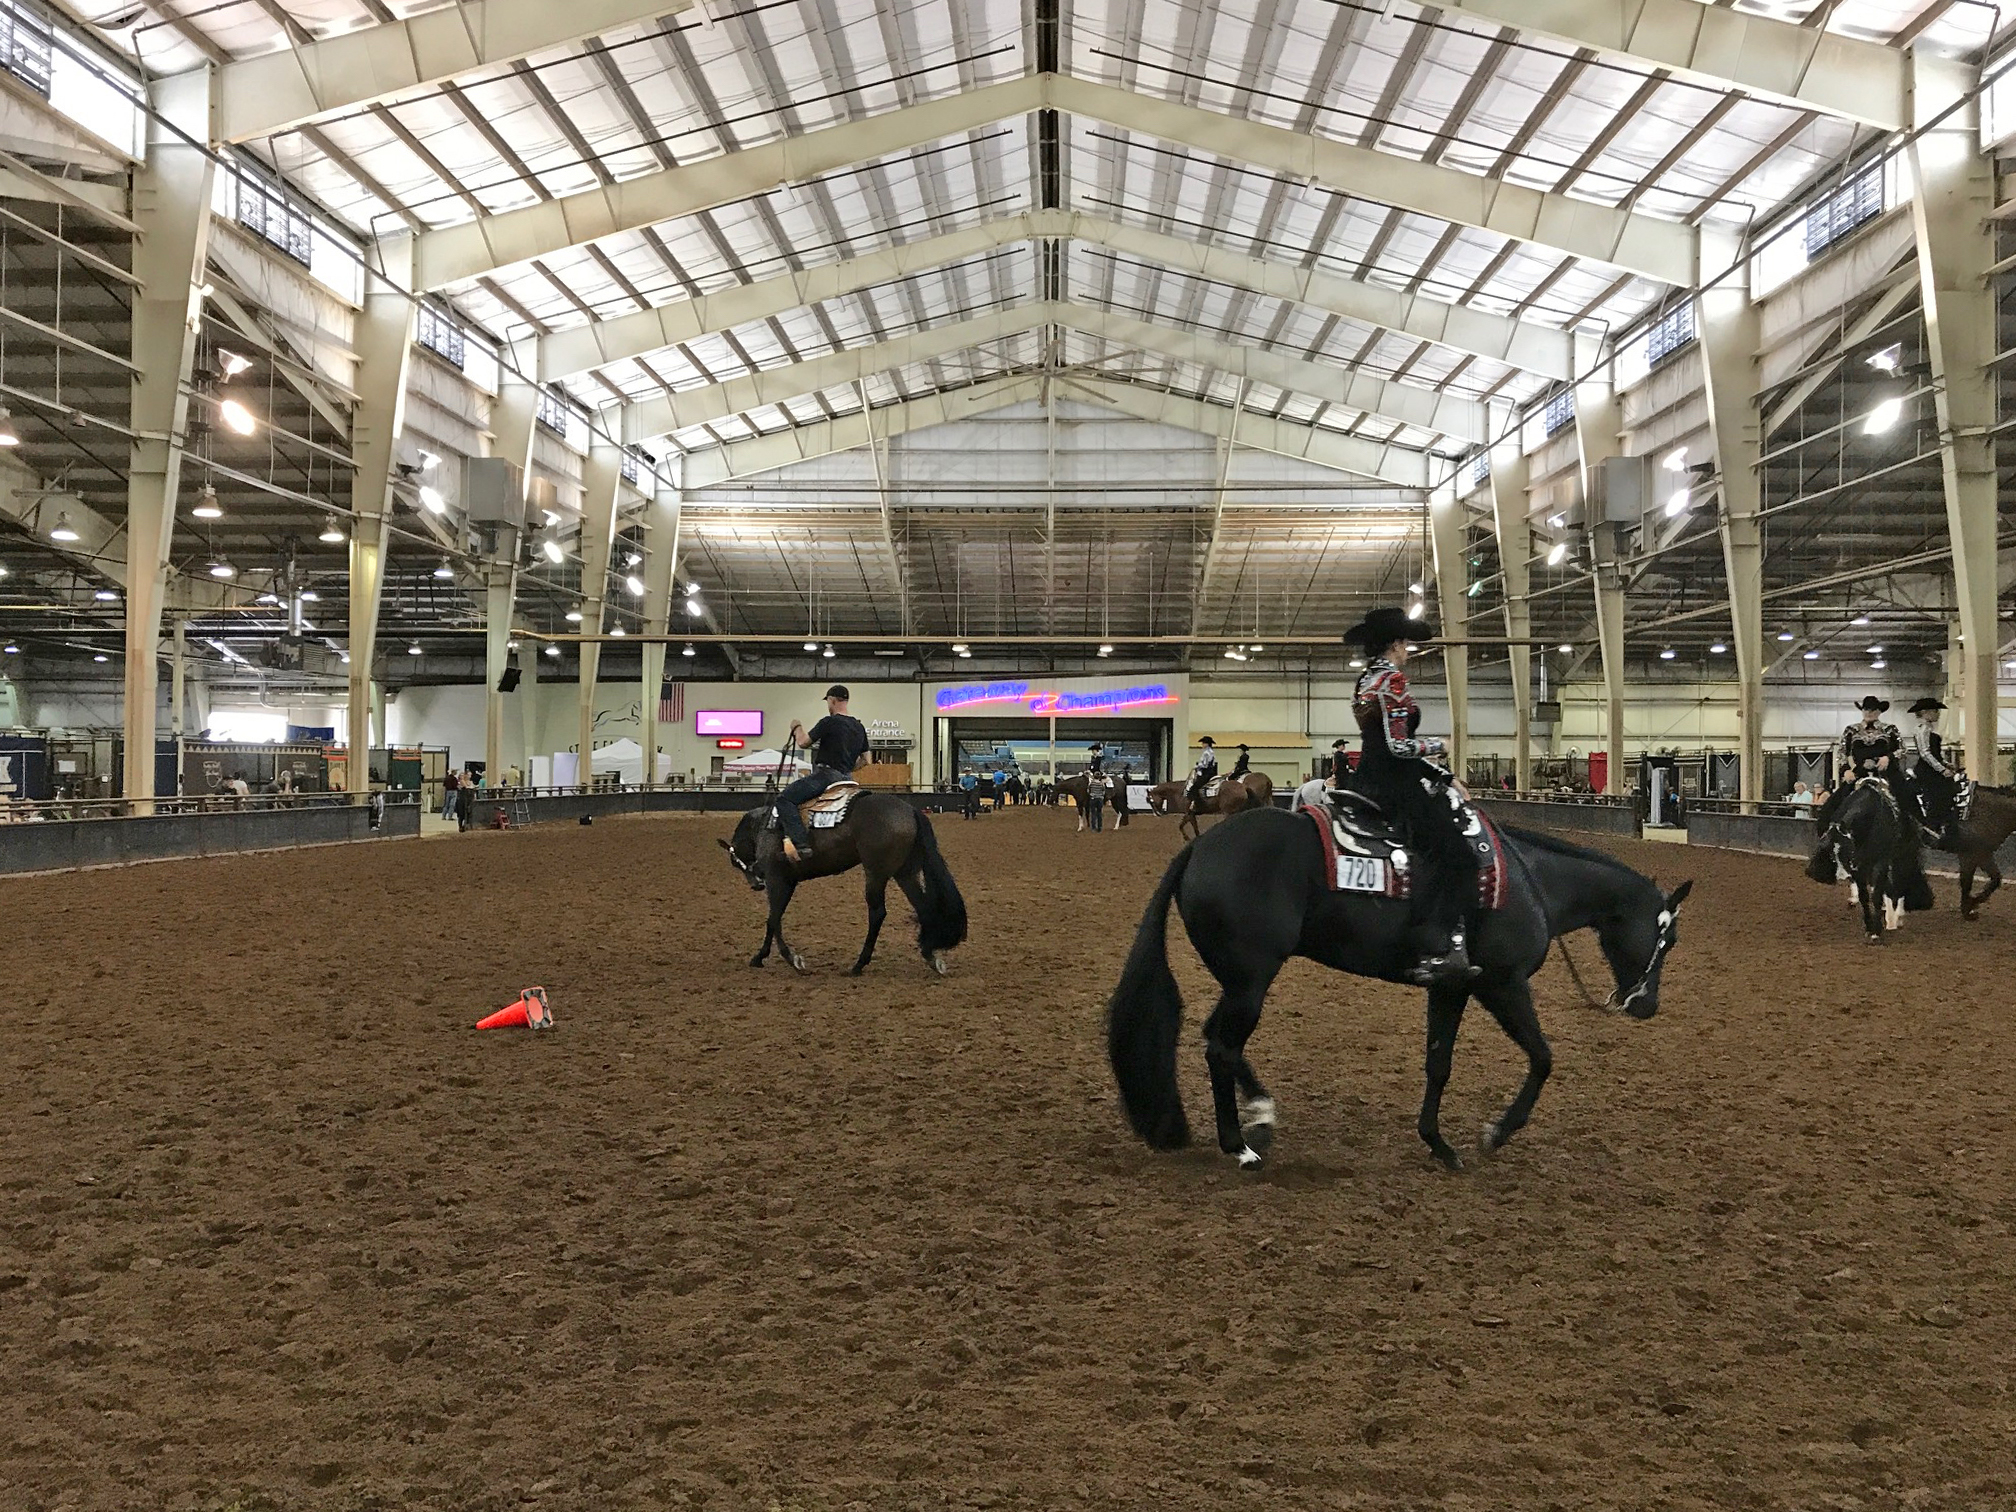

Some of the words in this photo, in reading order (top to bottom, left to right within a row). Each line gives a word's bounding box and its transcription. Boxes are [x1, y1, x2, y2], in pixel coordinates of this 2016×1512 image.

[936, 681, 1028, 706] Gateway
[1056, 683, 1168, 712] Champions
[865, 727, 906, 737] Entrance
[871, 719, 899, 728] Arena
[1345, 857, 1375, 888] 720
